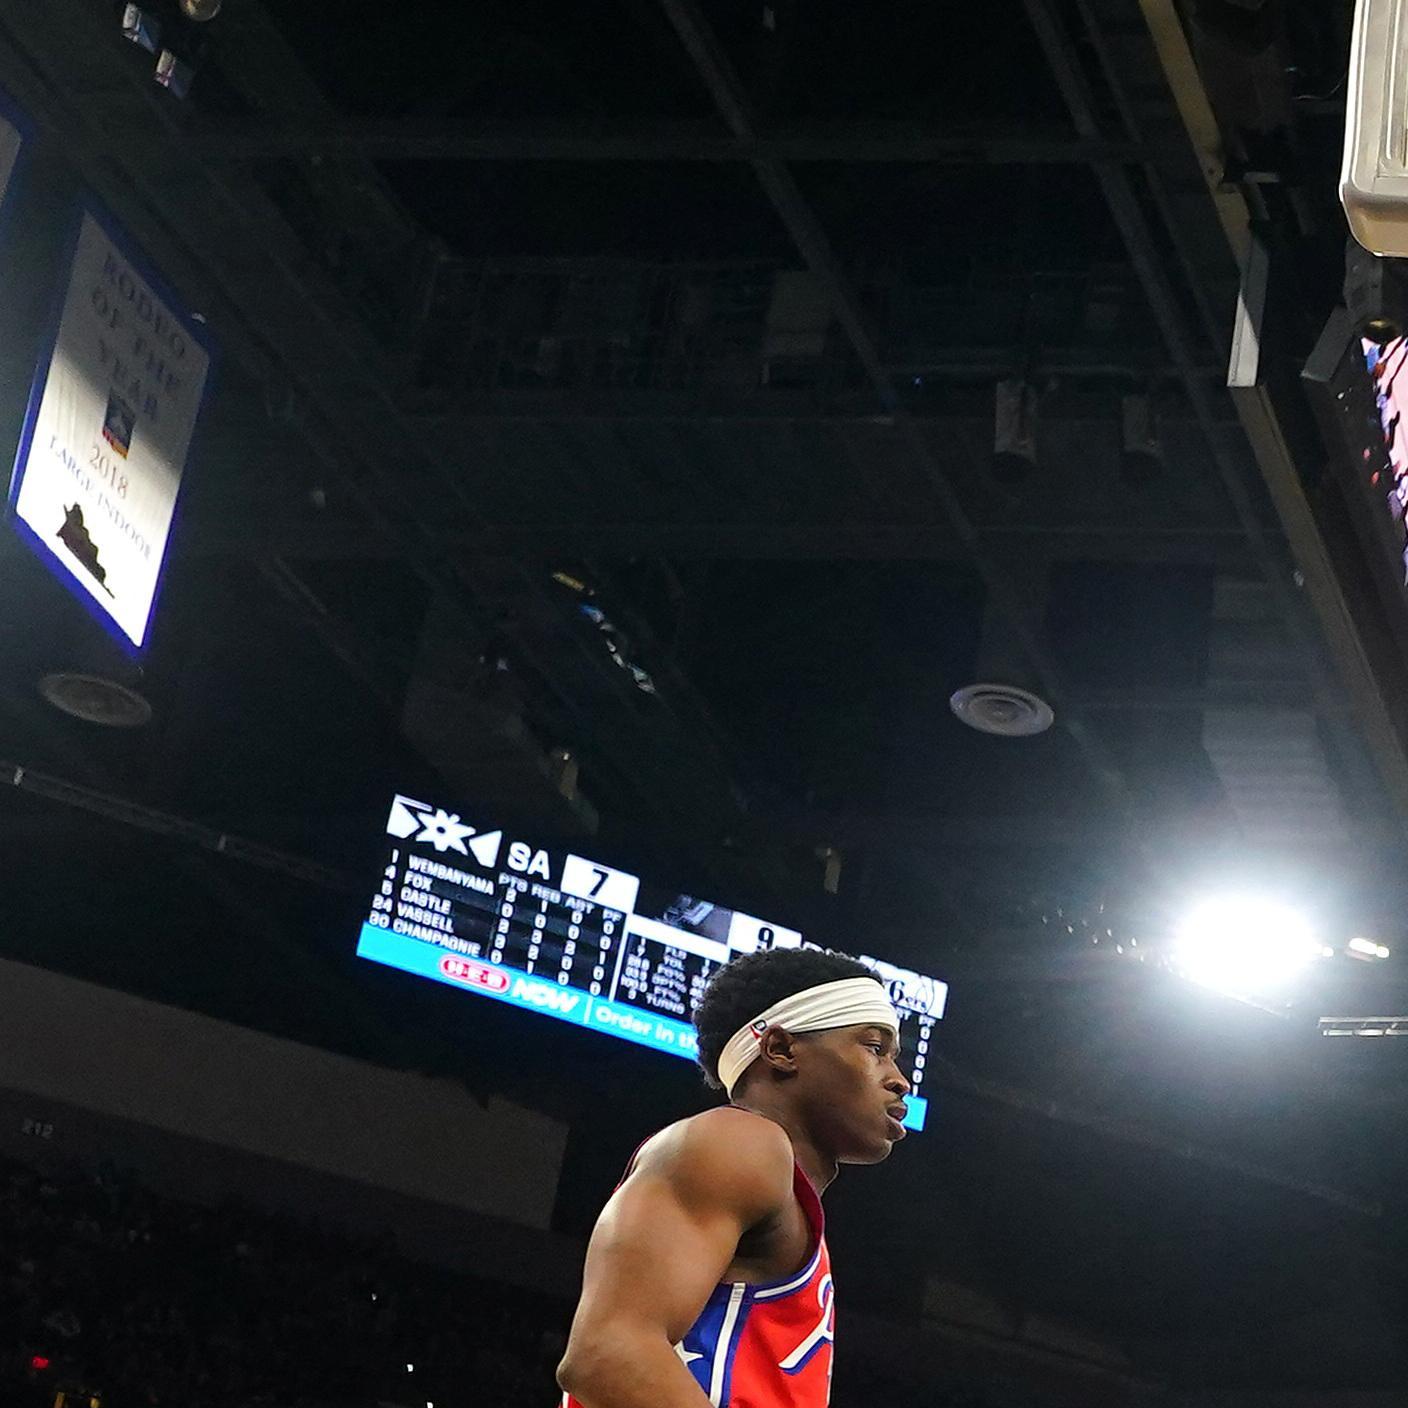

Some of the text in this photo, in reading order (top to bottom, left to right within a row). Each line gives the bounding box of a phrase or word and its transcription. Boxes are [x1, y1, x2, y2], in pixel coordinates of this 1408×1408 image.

[89, 443, 129, 500] 2018
[404, 870, 433, 891] FOX
[409, 854, 494, 895] WEMBANYAMA
[507, 841, 609, 896] SA 7
[397, 901, 454, 932] VASSELL
[400, 886, 451, 915] CASTLE
[392, 918, 481, 958] CHAMPAGNIE
[757, 927, 774, 949] 9
[595, 1003, 652, 1037] Order
[655, 1023, 675, 1043] in
